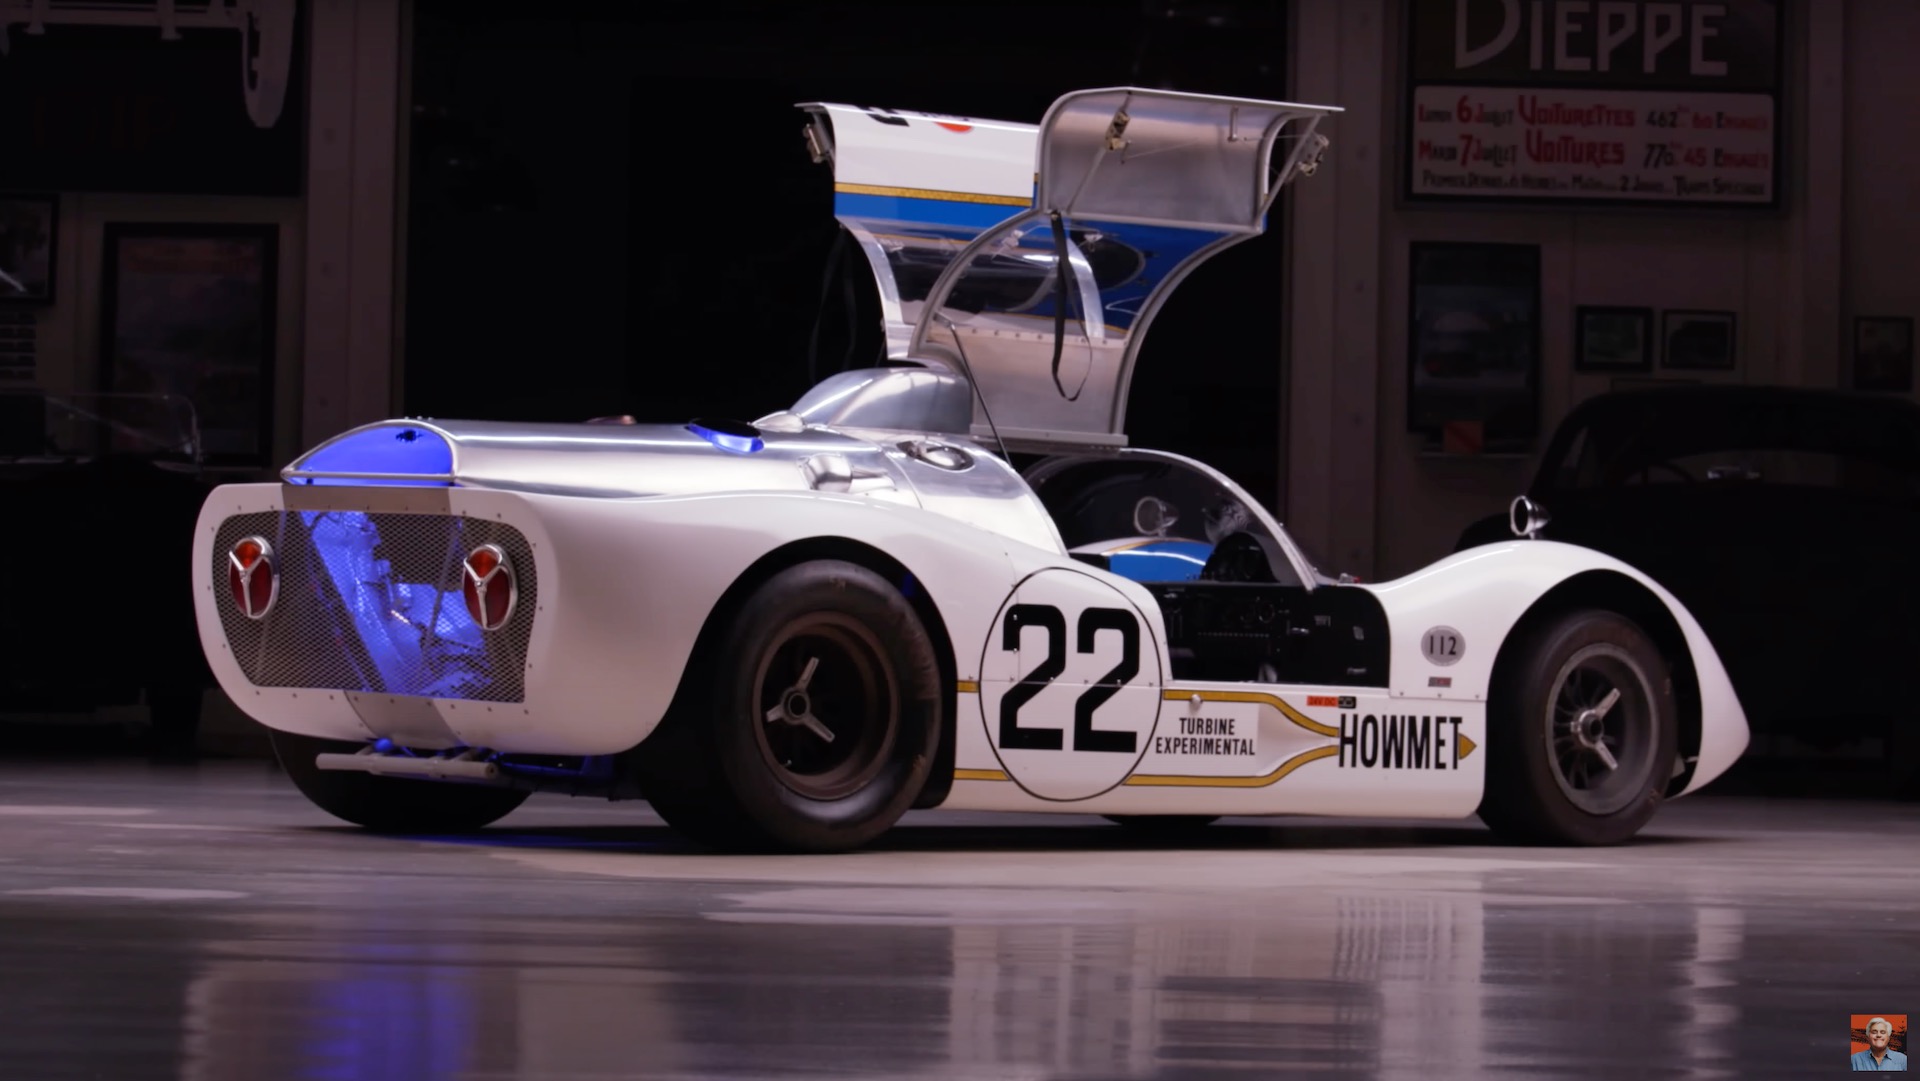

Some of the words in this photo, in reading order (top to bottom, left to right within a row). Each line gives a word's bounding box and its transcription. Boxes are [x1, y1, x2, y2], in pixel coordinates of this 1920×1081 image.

[1455, 0, 1728, 76] DIEPPE
[1457, 94, 1473, 124] 6
[1518, 94, 1635, 127] VOITURETTES
[1646, 109, 1678, 128] 462
[1459, 134, 1474, 166] 7
[1526, 129, 1624, 168] VOITURES
[1684, 147, 1707, 168] 45
[1429, 635, 1457, 656] 112
[999, 603, 1140, 754] 22
[1179, 717, 1236, 736] TURBINE
[1338, 714, 1463, 770] HOWMET
[1155, 737, 1256, 756] EXPERIMENTAL
